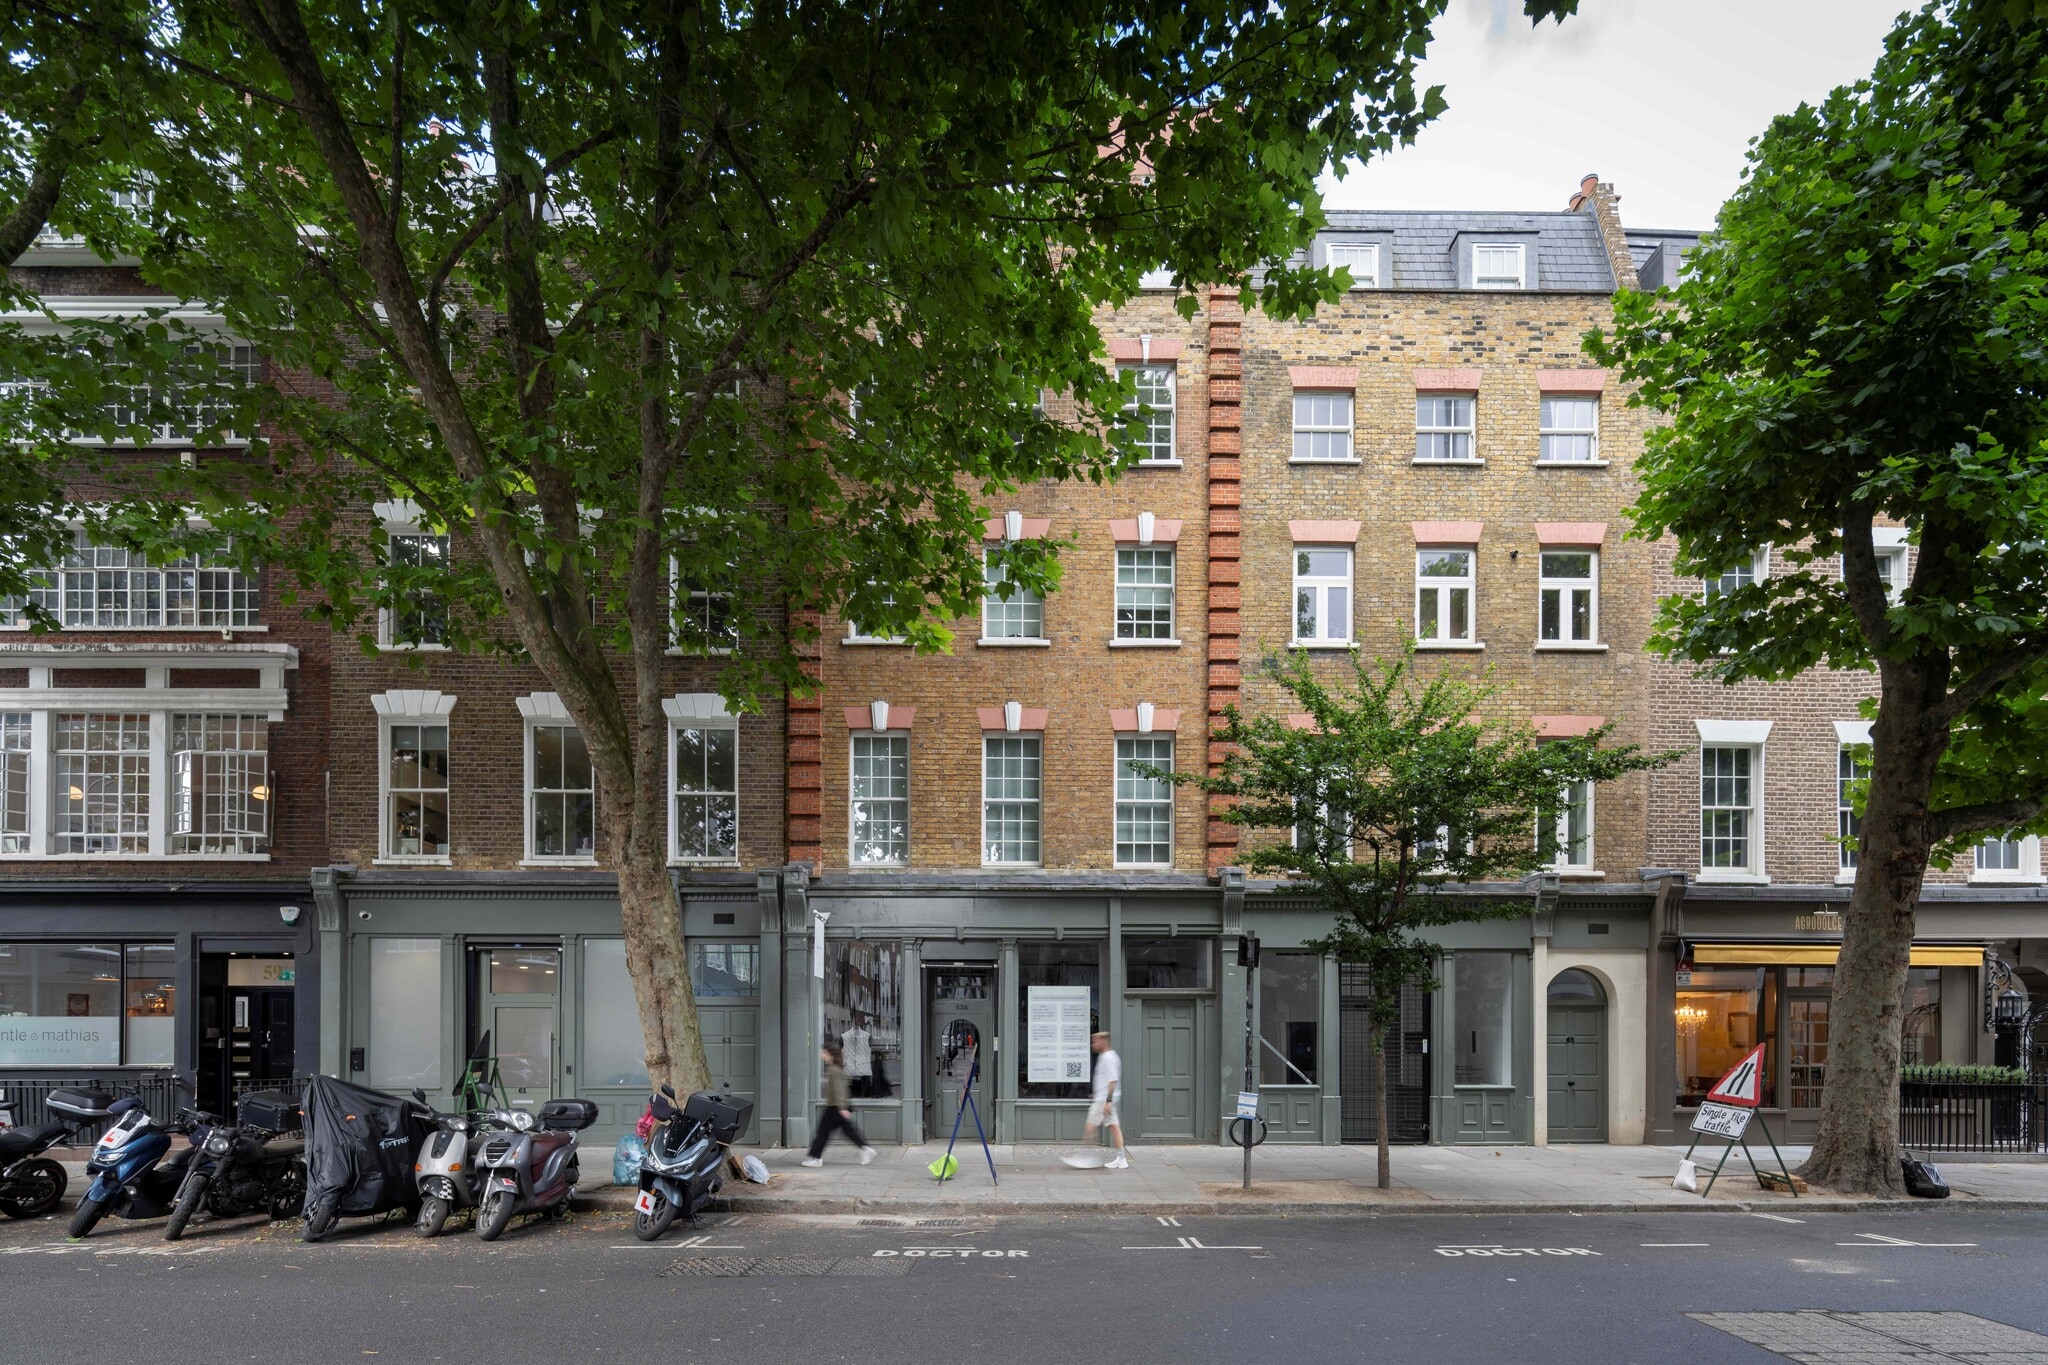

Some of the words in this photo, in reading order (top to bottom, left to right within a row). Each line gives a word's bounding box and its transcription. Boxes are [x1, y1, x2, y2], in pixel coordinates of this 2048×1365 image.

[1795, 916, 1842, 930] AGRODOLCE
[263, 965, 282, 980] 59
[0, 1028, 27, 1042] ntle
[42, 1028, 99, 1042] mathias
[1701, 1106, 1727, 1119] Single
[1731, 1111, 1746, 1123] file
[1703, 1120, 1731, 1133] traffic
[640, 1195, 650, 1210] L
[872, 1249, 1029, 1258] DOCTOR
[1433, 1247, 1603, 1257] DOCTOR
